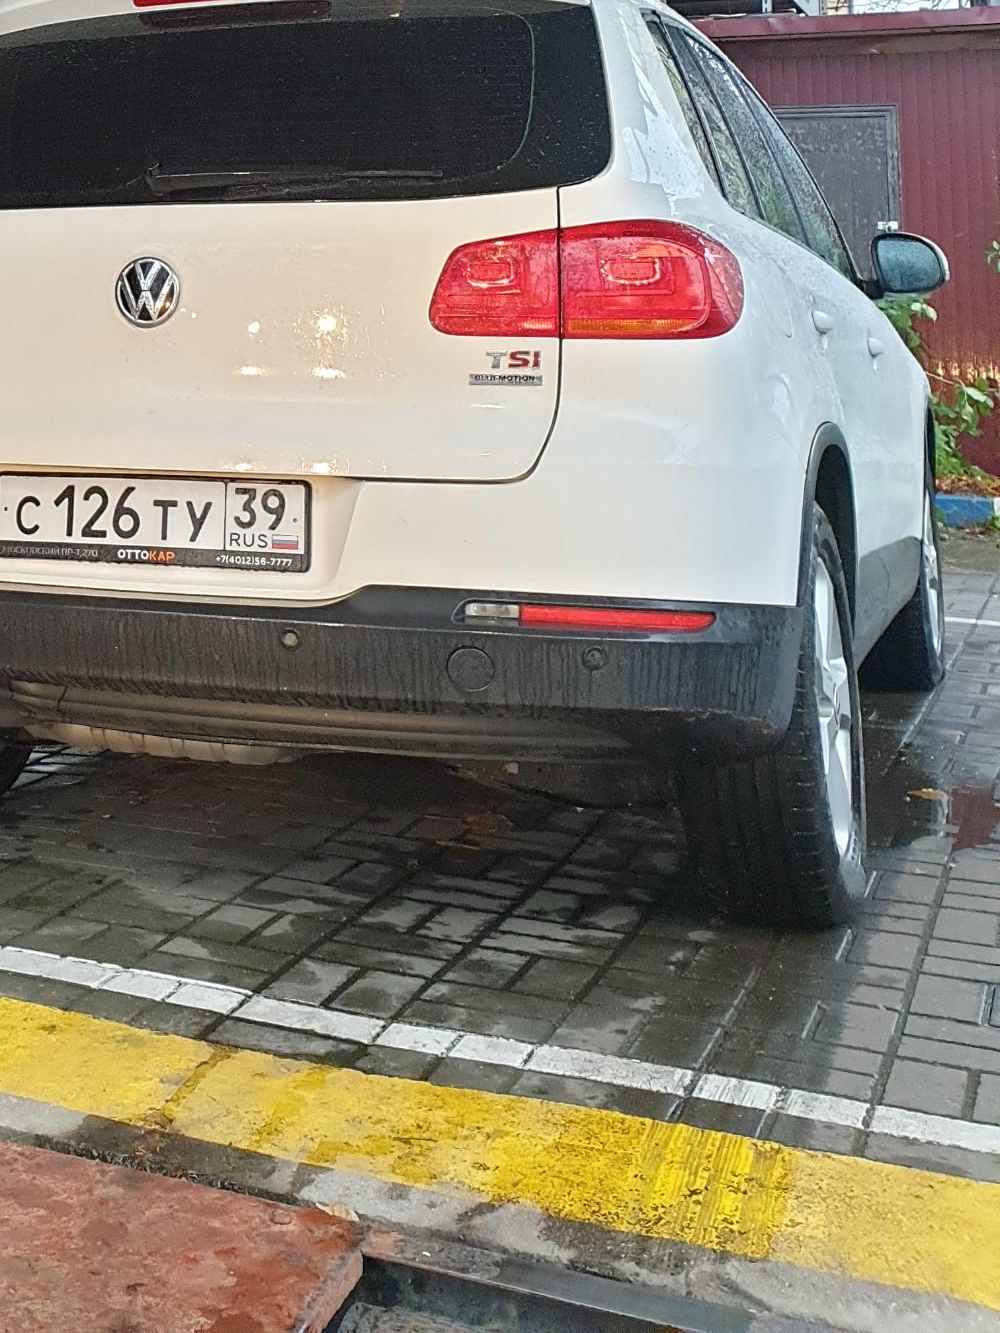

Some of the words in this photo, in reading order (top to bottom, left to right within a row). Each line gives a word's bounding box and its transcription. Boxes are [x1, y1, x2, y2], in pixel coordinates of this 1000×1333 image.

[486, 350, 542, 369] TSI
[233, 487, 286, 531] 39
[229, 532, 268, 549] RUS
